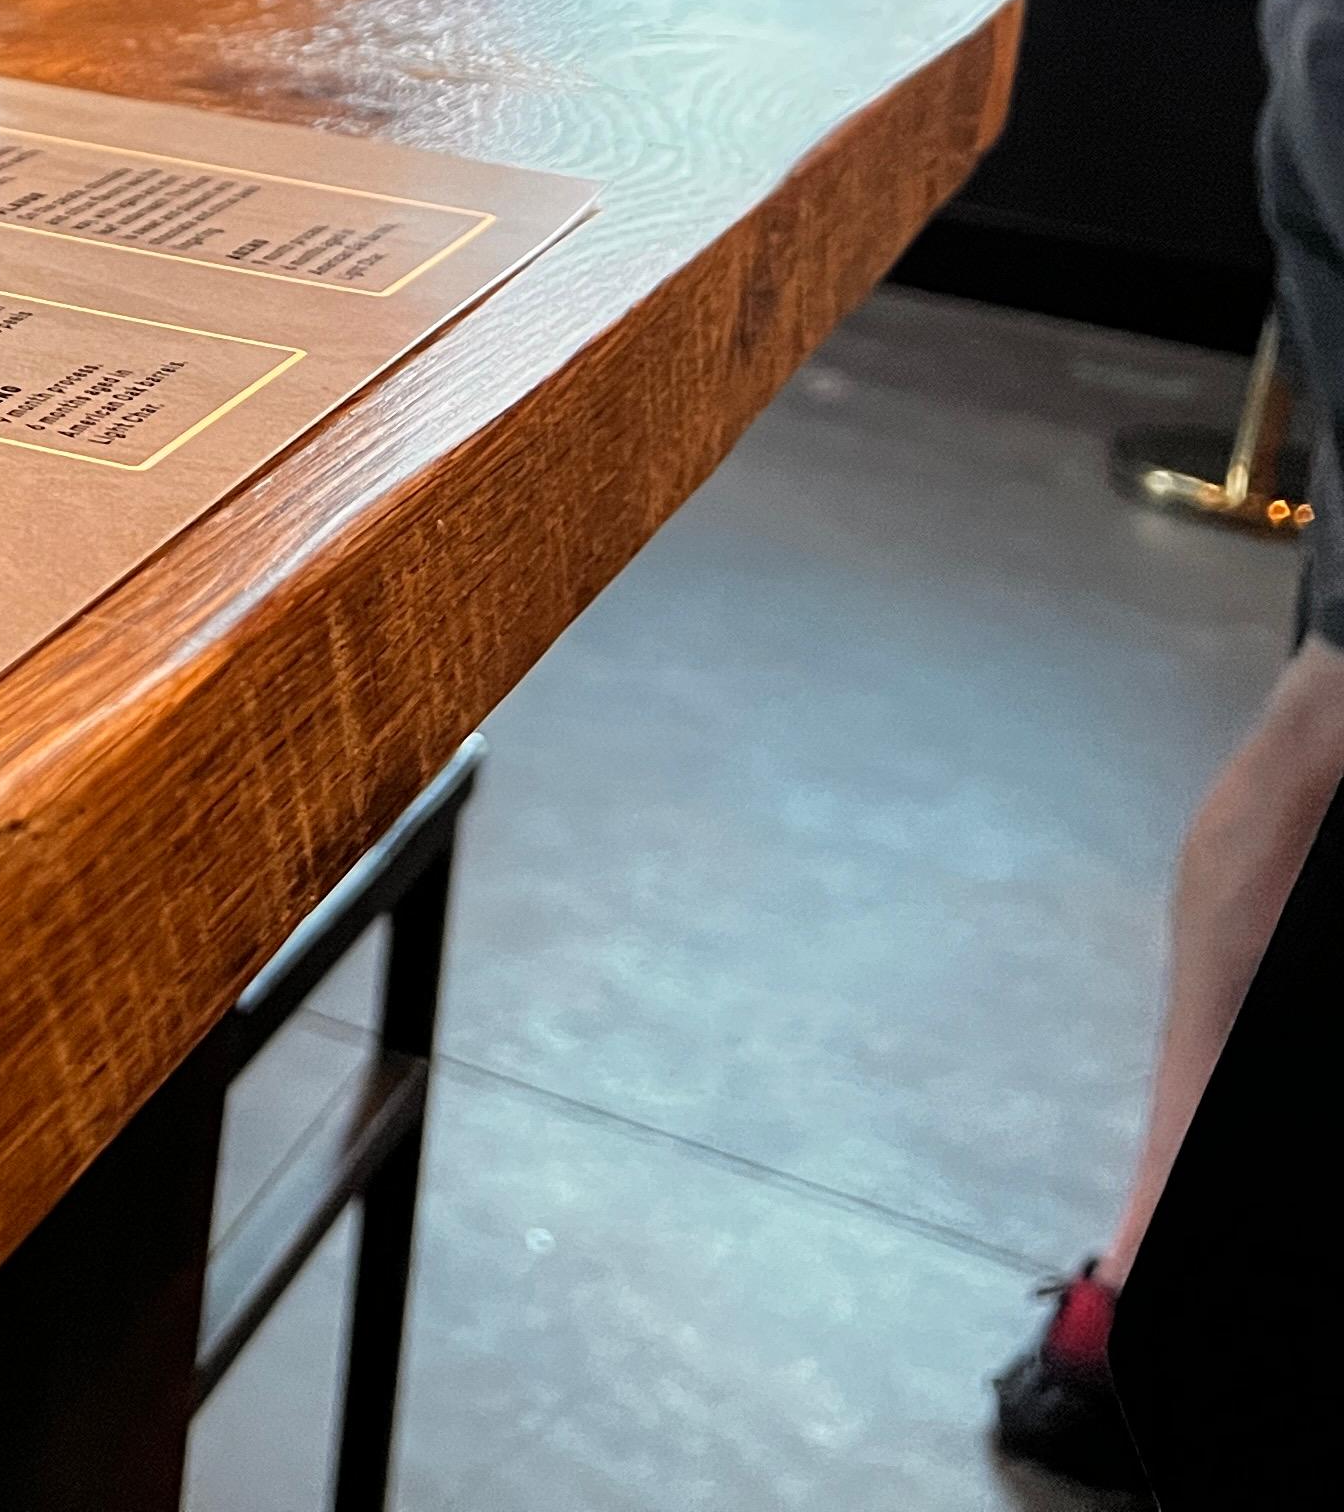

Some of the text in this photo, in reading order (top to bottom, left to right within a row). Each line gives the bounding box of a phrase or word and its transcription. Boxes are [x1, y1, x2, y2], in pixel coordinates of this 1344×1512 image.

[5, 392, 55, 418] month
[25, 423, 46, 431] 6
[38, 395, 92, 425] months
[83, 376, 121, 396] aged
[56, 401, 125, 439] American
[111, 386, 149, 402] Oak
[87, 422, 135, 446] Light
